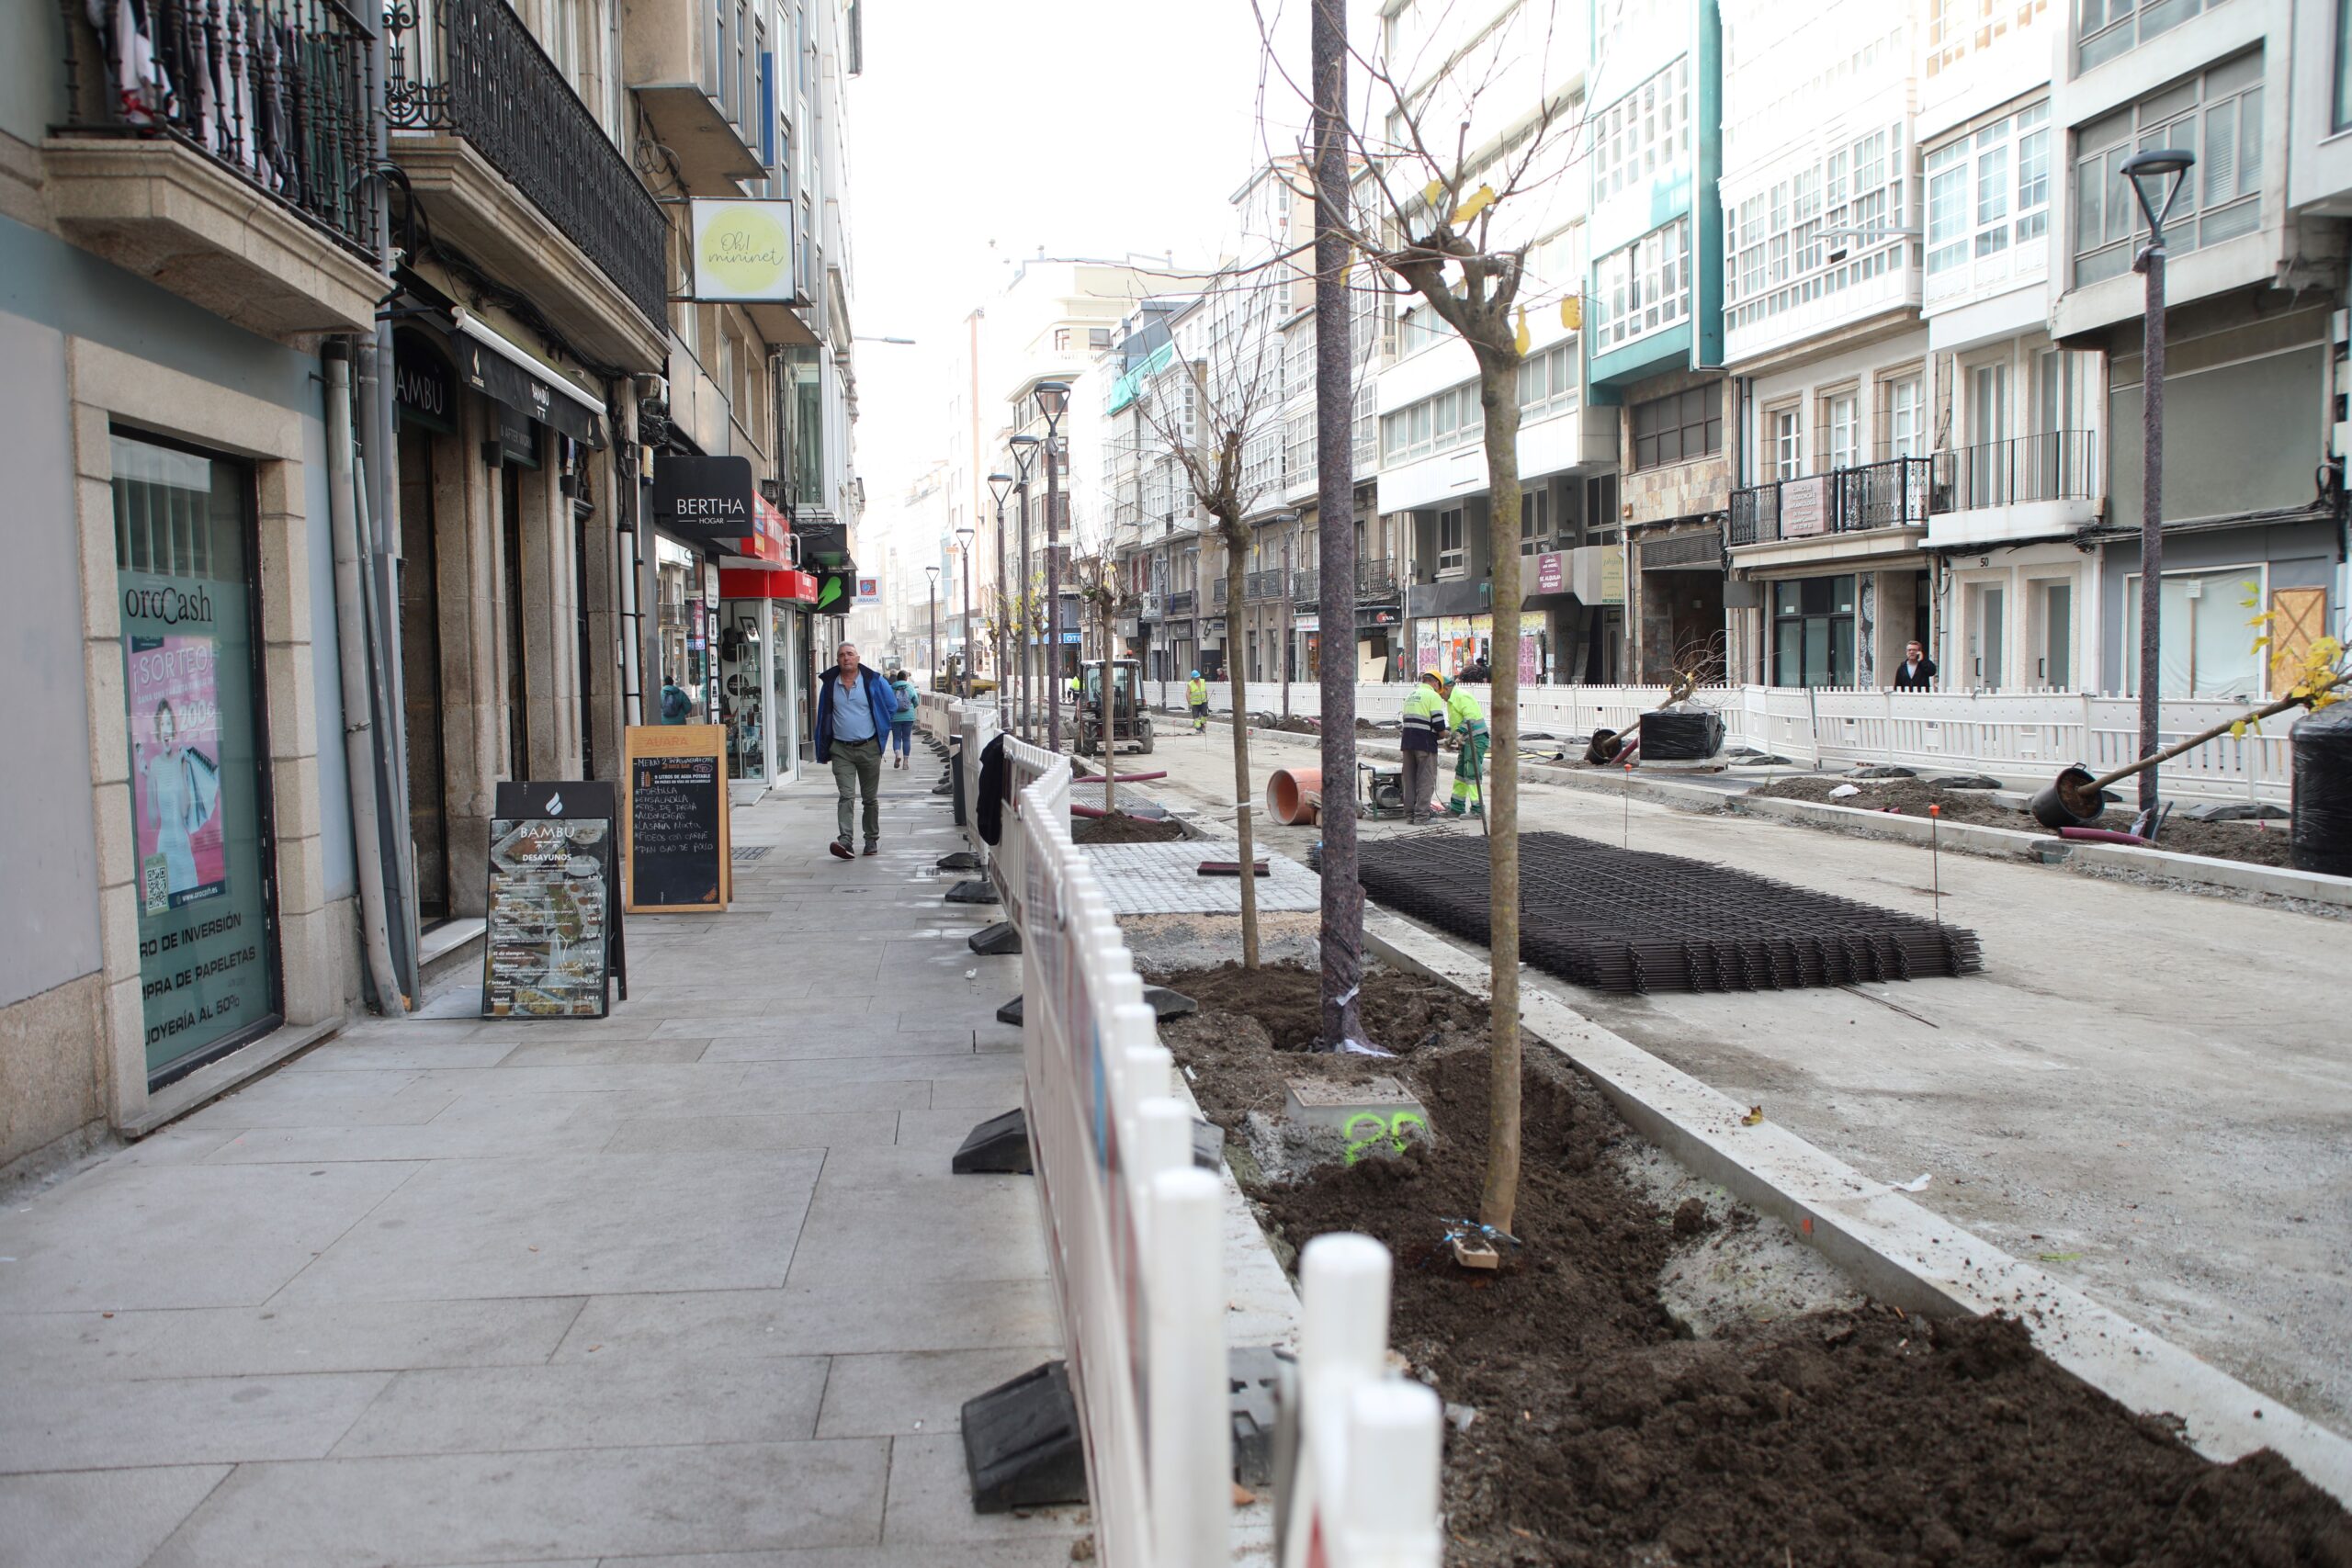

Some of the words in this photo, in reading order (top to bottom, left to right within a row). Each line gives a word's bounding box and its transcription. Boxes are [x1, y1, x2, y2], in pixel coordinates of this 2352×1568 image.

[721, 231, 750, 252] Oh!
[708, 248, 784, 265] mininet
[677, 498, 745, 514] BERTHA
[1980, 557, 1989, 567] 50
[646, 738, 689, 747] AUARA
[522, 853, 572, 862] DESAYUNOS
[162, 931, 178, 952] DE
[182, 911, 242, 945] INVERSIÓN
[175, 969, 192, 989] DE
[196, 945, 256, 981] PAPELETAS
[198, 1005, 213, 1023] AL
[216, 993, 240, 1015] 50%
